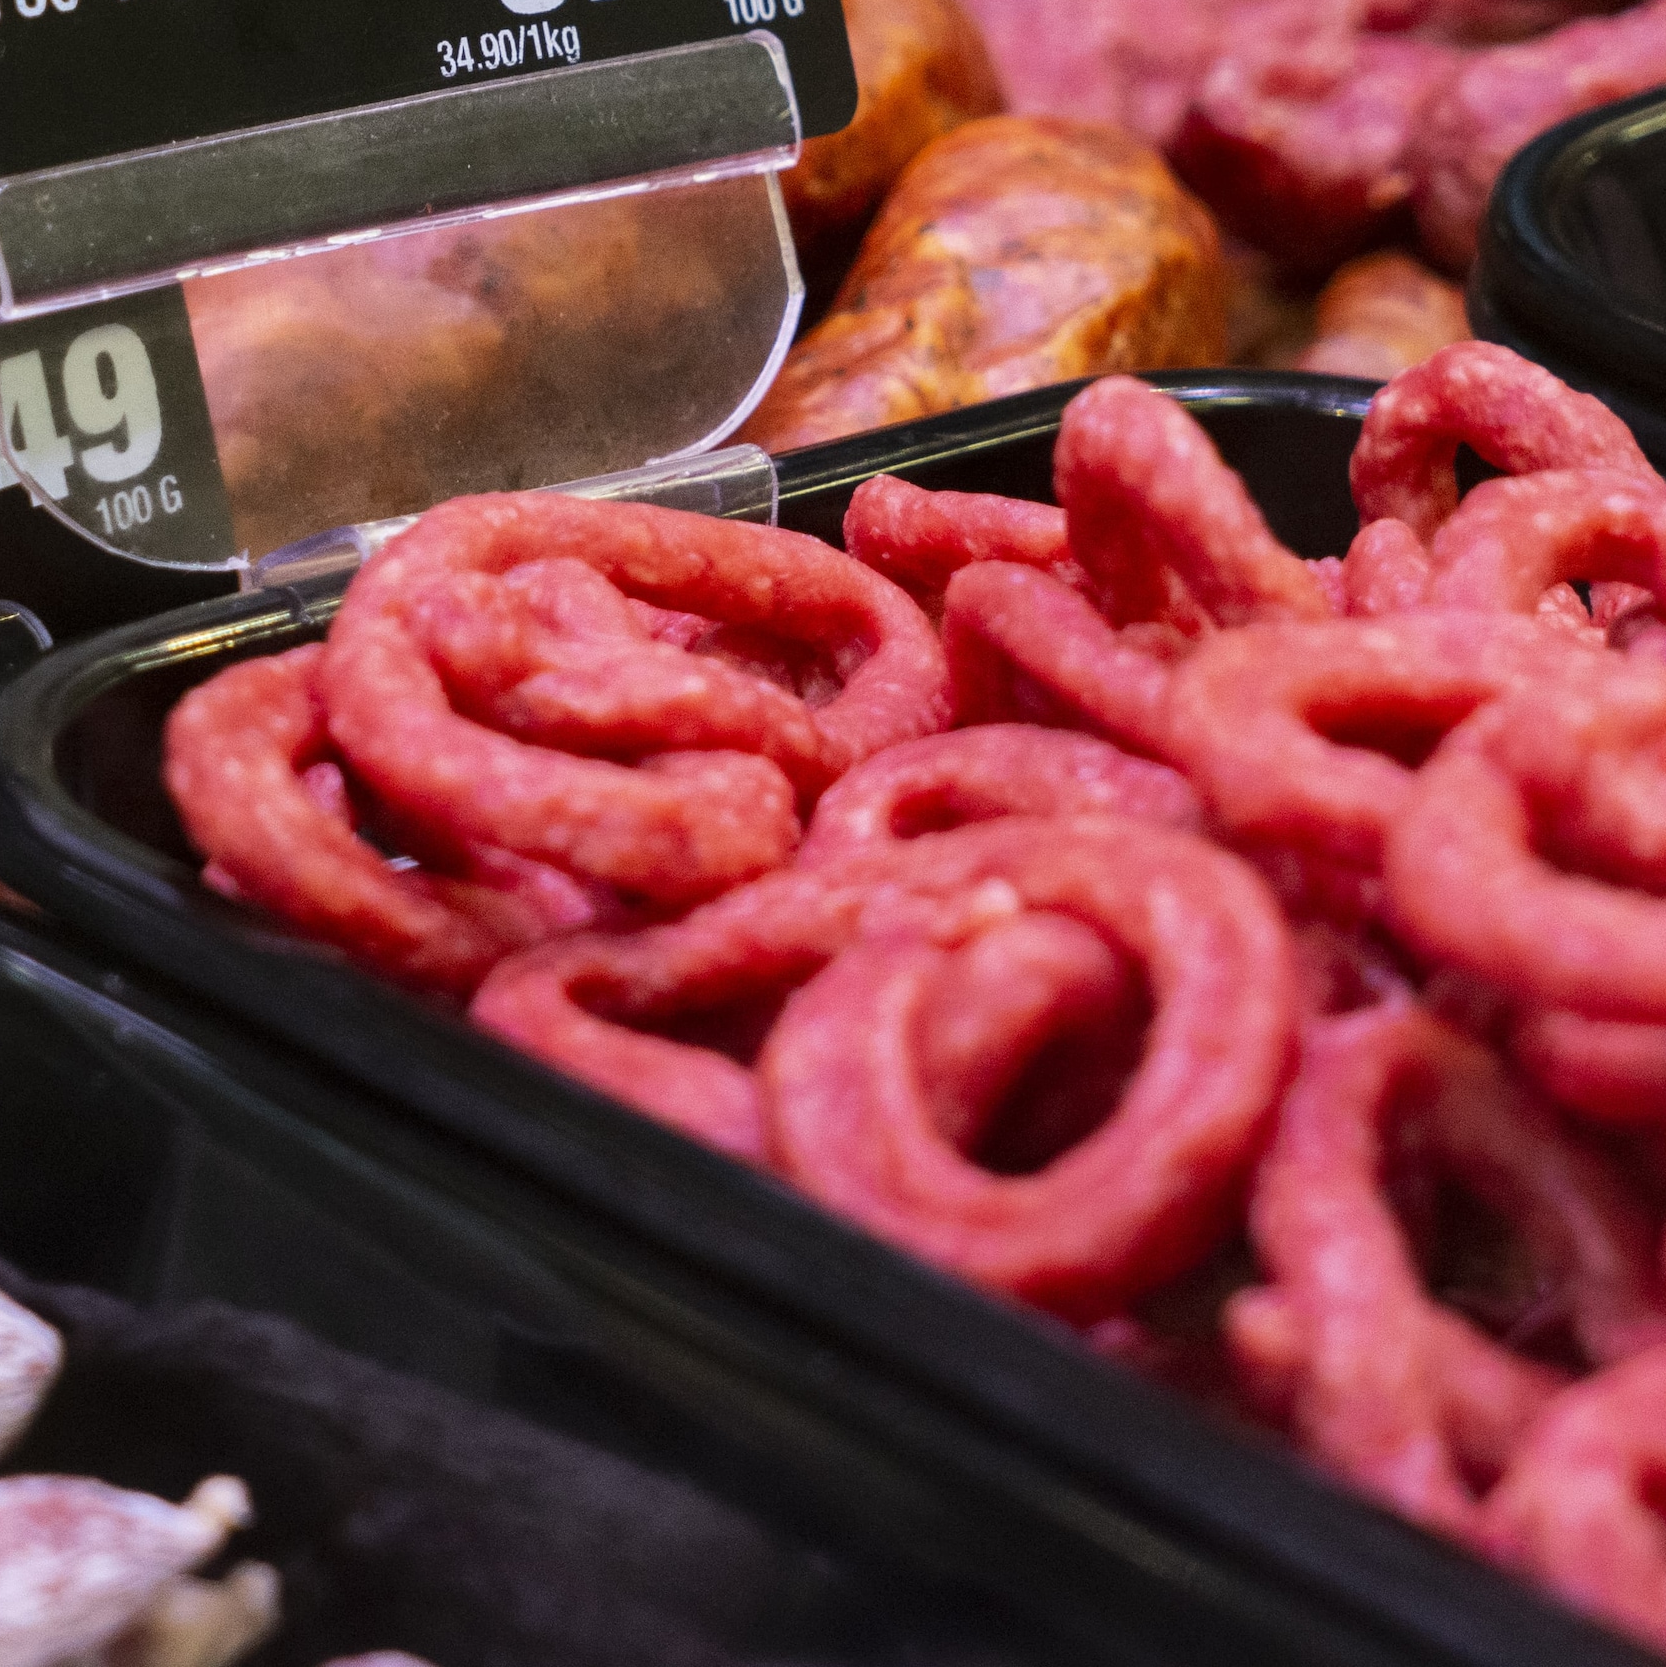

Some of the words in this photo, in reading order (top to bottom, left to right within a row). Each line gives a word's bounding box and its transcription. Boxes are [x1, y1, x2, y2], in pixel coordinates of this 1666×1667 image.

[437, 21, 581, 78] 34.90/1kg
[94, 488, 153, 534] 100
[159, 474, 183, 513] G
